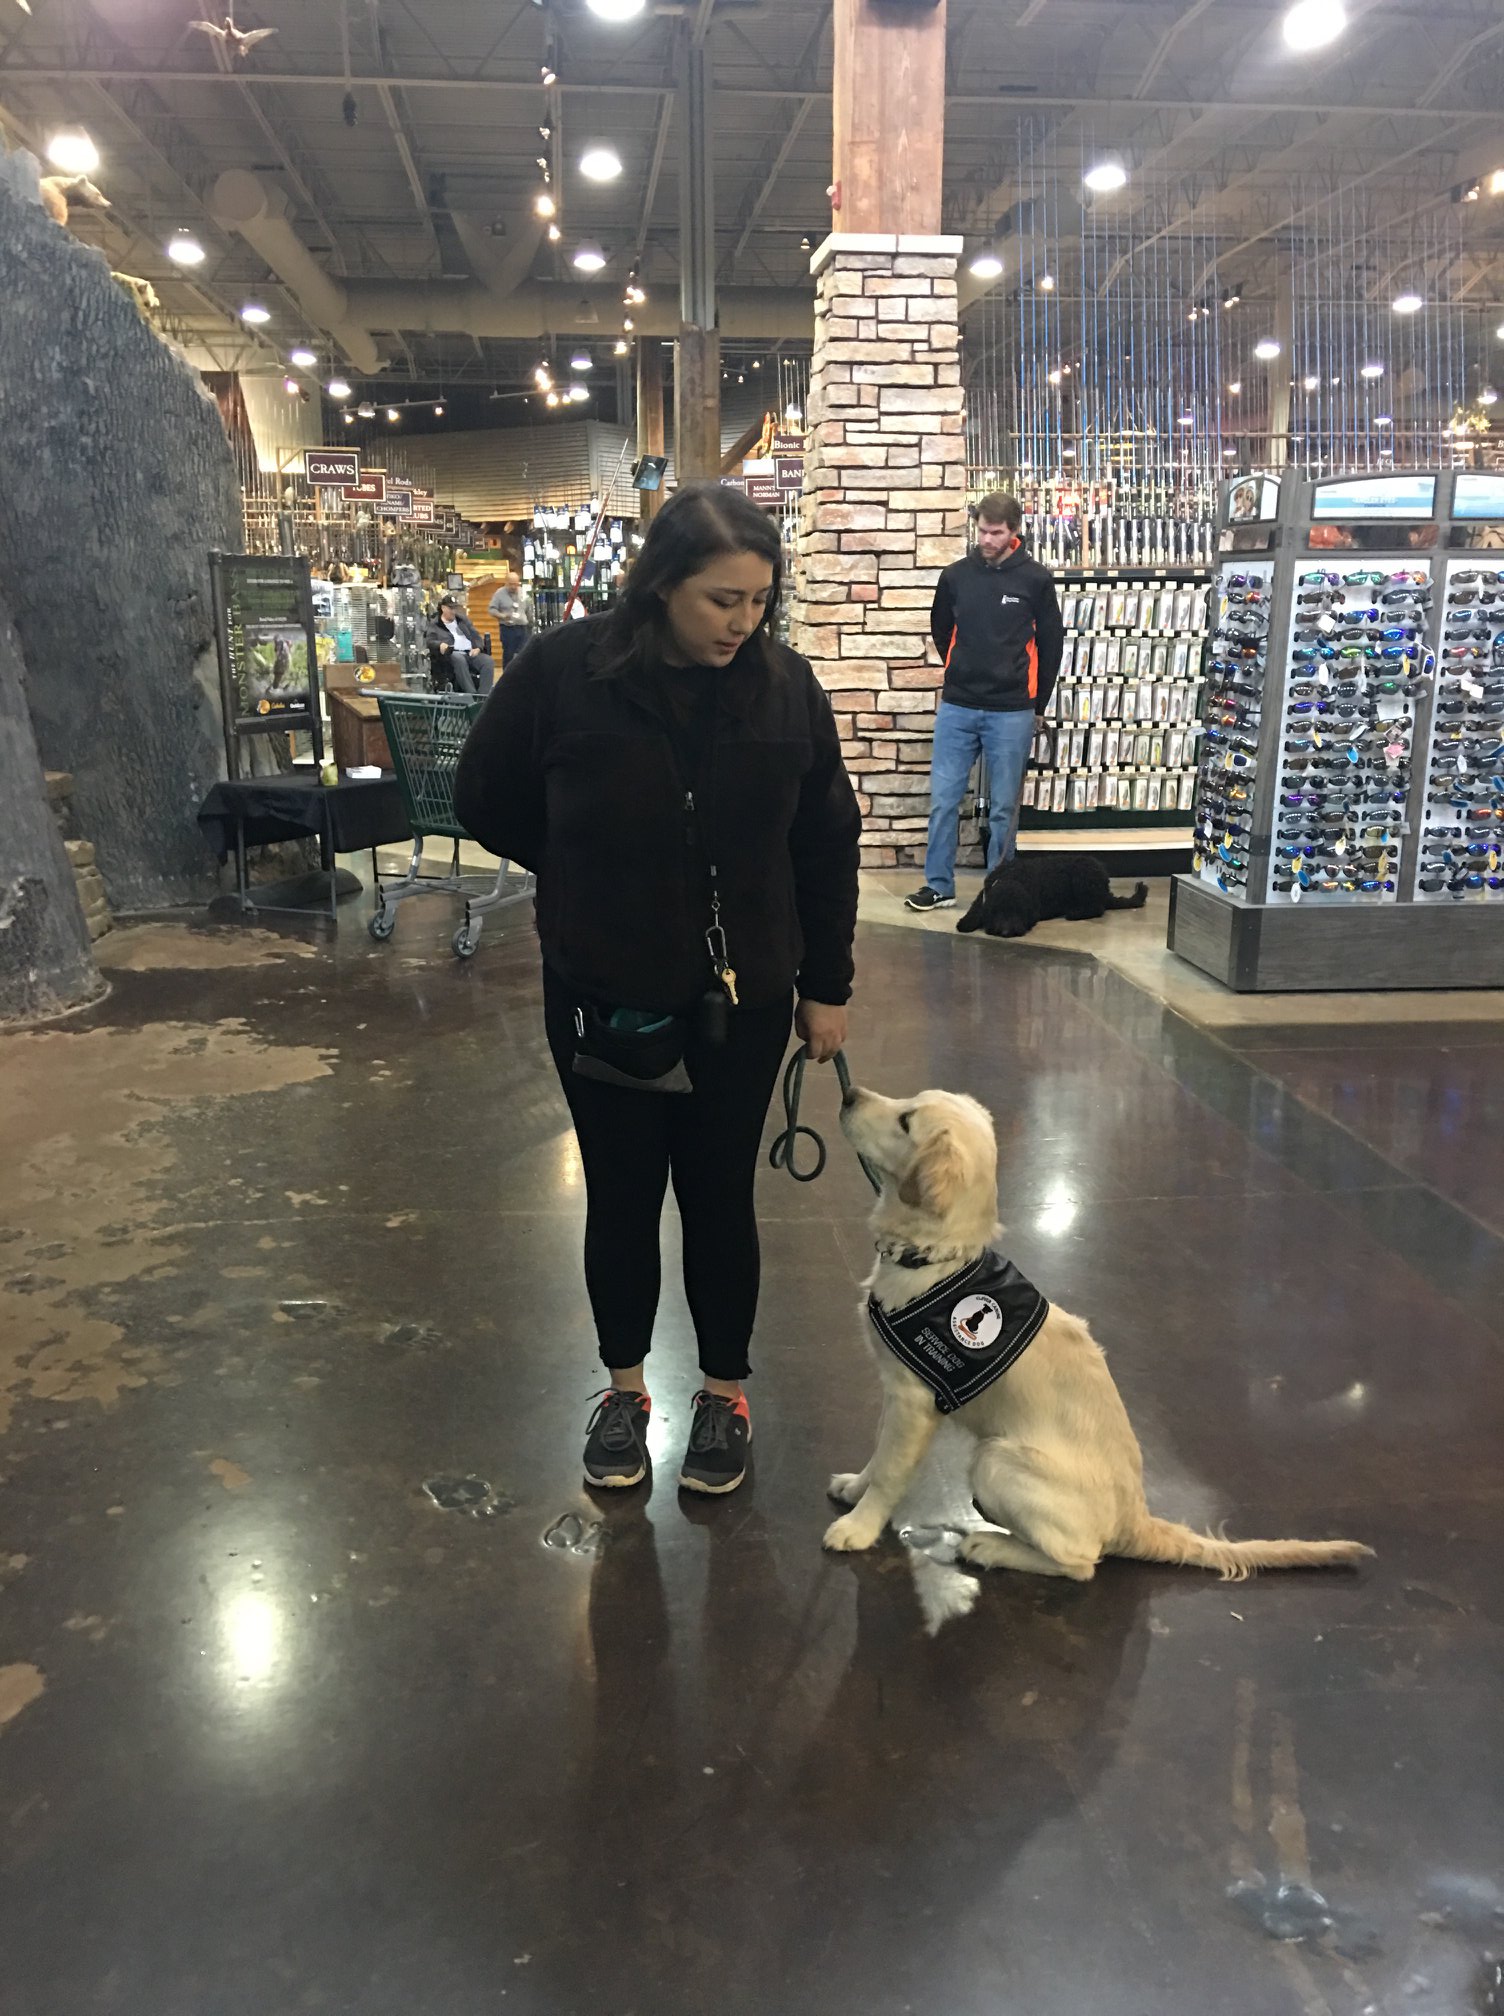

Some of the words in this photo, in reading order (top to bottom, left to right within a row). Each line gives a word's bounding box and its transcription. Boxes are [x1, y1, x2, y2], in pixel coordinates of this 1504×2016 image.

[774, 440, 800, 449] Bionic
[310, 463, 355, 475] CRAWS
[395, 477, 412, 486] Rods
[720, 478, 745, 486] Carbon
[226, 626, 236, 660] HUNT
[233, 622, 250, 717] MONSTER
[914, 1334, 926, 1346] IN
[922, 1343, 956, 1373] TRAINING
[921, 1327, 950, 1355] SERVICE
[947, 1352, 966, 1369] DOG
